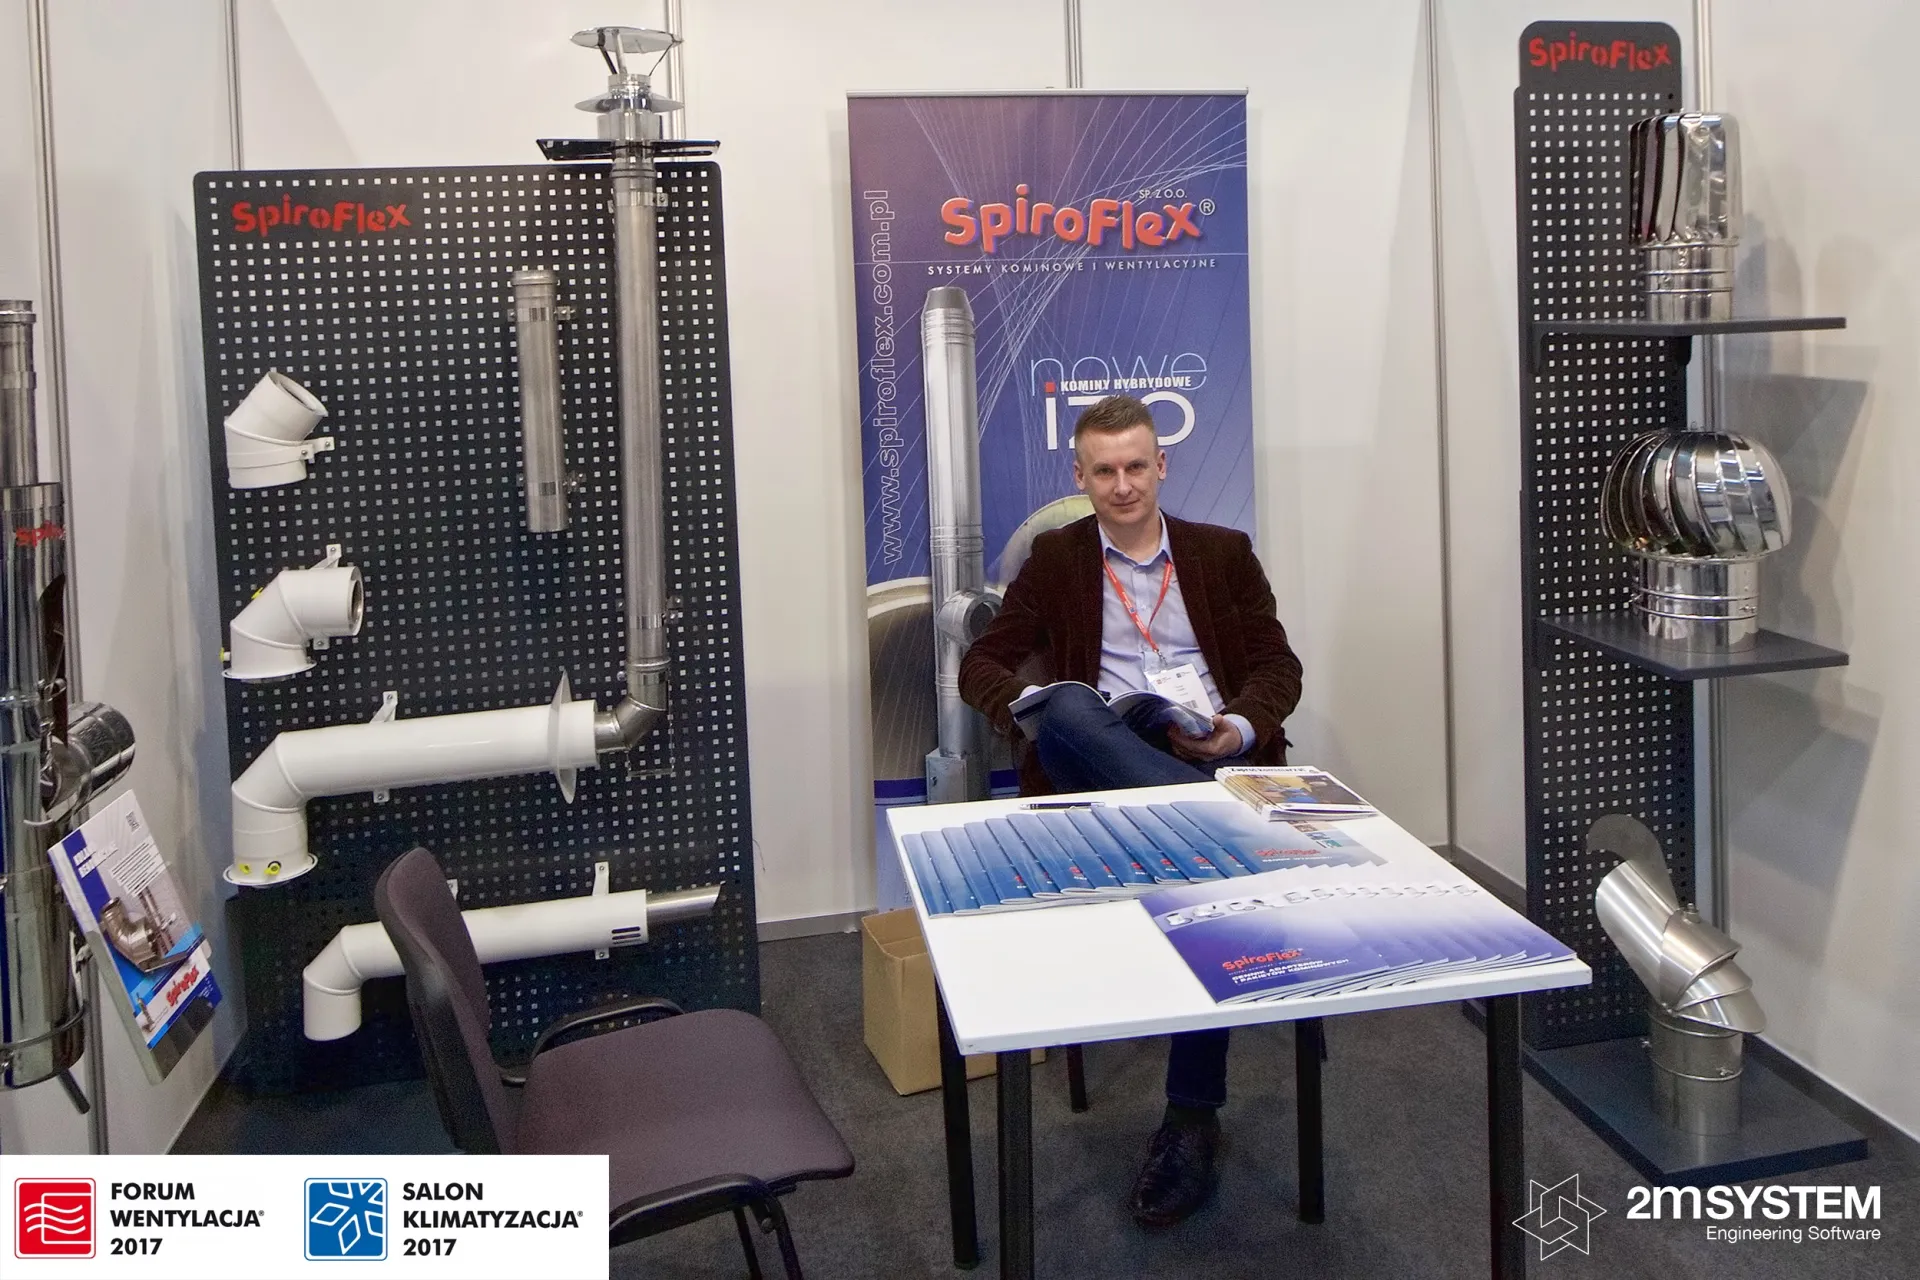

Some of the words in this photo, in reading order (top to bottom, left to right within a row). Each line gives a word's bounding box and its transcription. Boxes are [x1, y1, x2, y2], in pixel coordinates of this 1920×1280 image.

[1529, 31, 1672, 71] SpiroFlex
[232, 192, 412, 238] SpiroFlex
[927, 263, 992, 275] SYSTEMY
[1001, 261, 1084, 273] KOMINOWE
[1092, 261, 1097, 271] I
[1105, 258, 1217, 270] WENTYLACYJNE
[864, 190, 904, 565] www.spiroflex.com.pl
[1031, 352, 1207, 397] nowe
[1060, 380, 1110, 392] KOMINY
[1114, 376, 1192, 390] HYBRYDOWE
[1222, 949, 1303, 971] SpiroFlex
